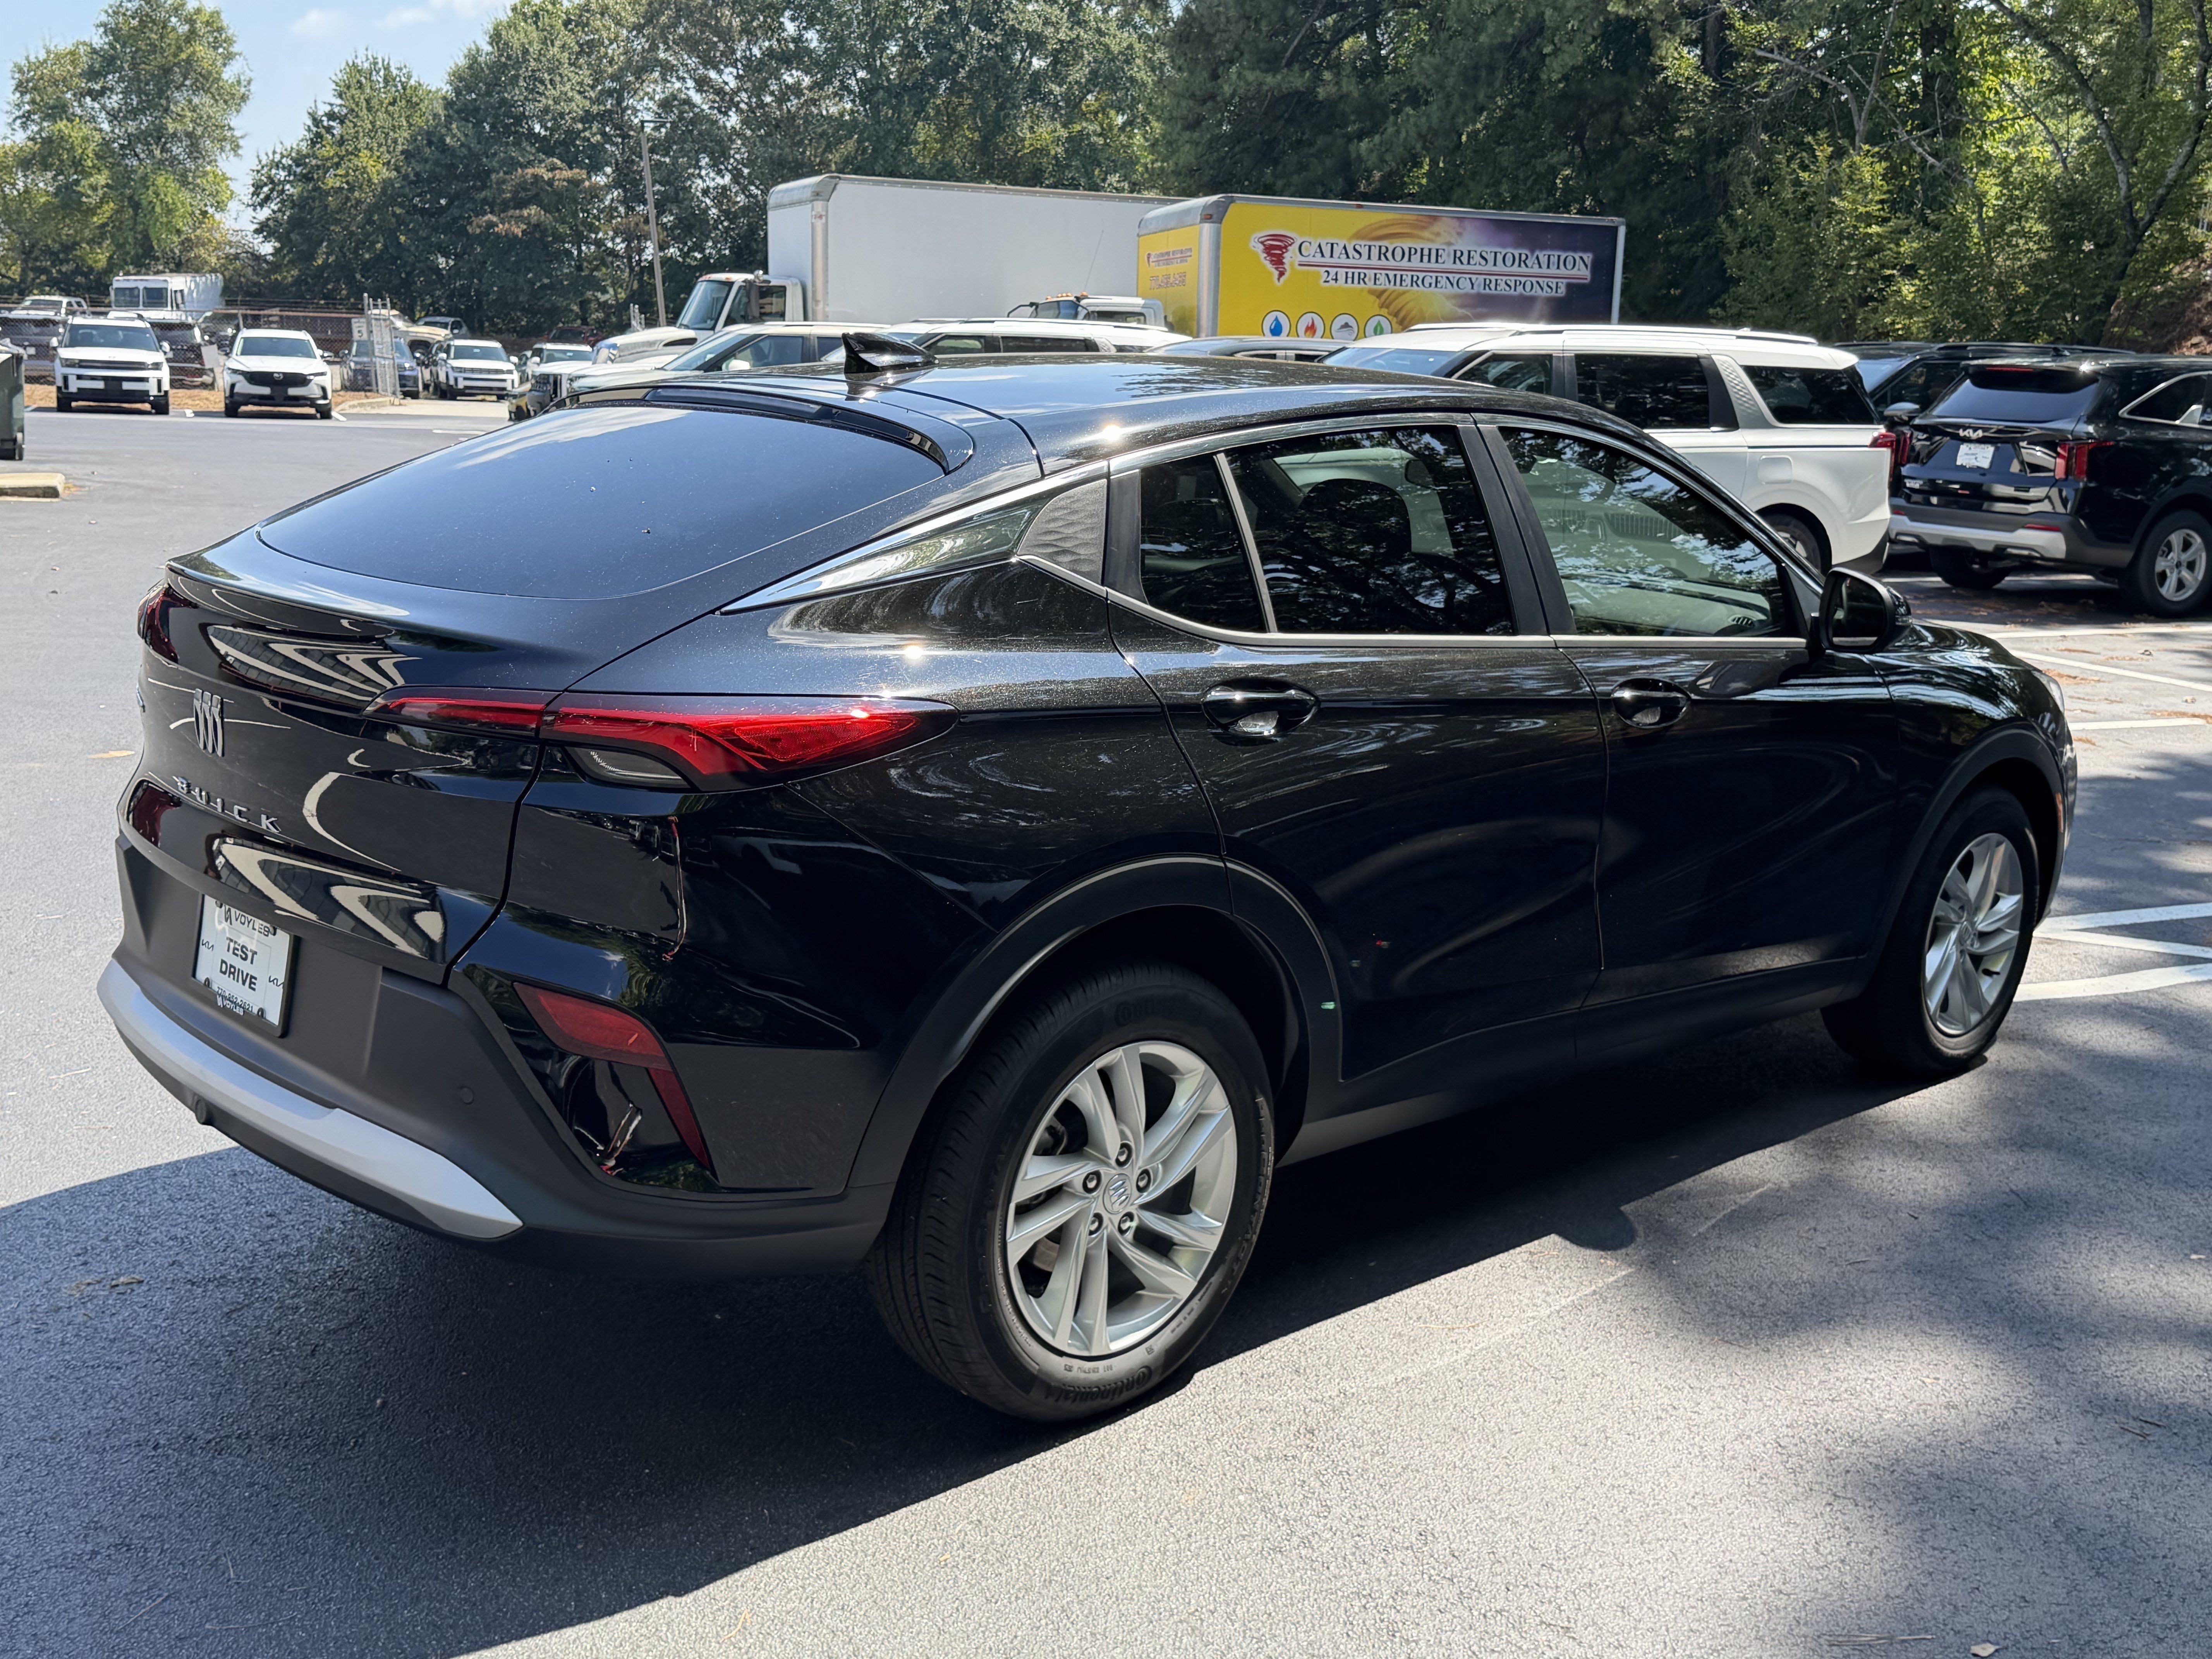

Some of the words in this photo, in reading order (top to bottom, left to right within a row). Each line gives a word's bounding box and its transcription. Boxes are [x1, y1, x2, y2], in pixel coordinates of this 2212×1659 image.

[1298, 240, 1445, 264] CATASTROPHE
[1453, 249, 1590, 271] RESTORATION
[1323, 270, 1338, 283] 24
[1345, 271, 1367, 285] HR
[1373, 272, 1479, 290] EMERGENCY
[1482, 277, 1564, 294] RESPONSE
[177, 776, 281, 833] BUICK
[234, 910, 270, 937] VOYLES
[226, 936, 258, 965] TEST
[219, 958, 258, 992] DRIVE
